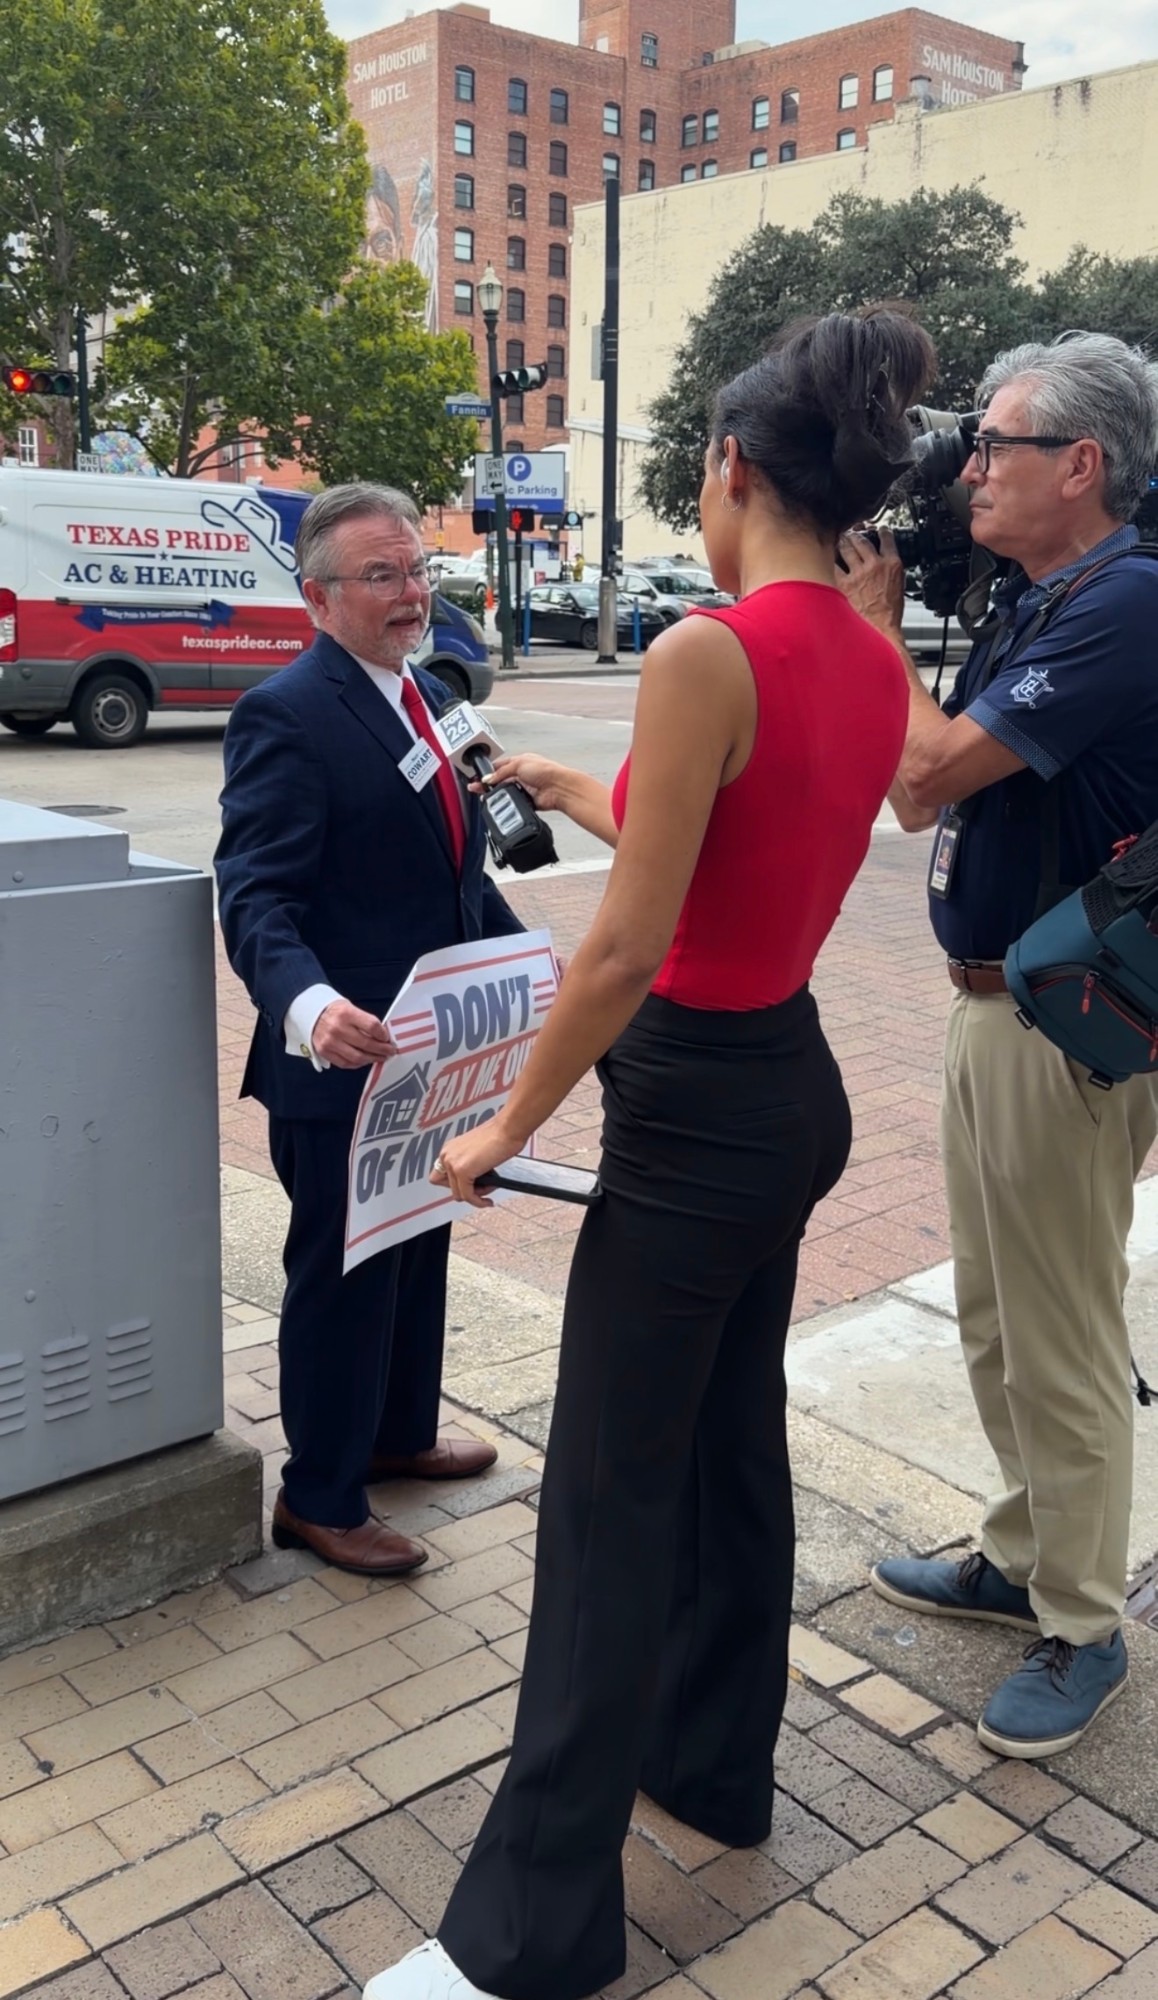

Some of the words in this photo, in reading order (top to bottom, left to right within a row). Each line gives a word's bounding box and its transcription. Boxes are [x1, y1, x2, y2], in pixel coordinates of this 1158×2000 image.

[353, 60, 377, 84] SAM
[379, 42, 427, 75] HOUSTON
[922, 44, 951, 75] SAM
[952, 54, 1005, 92] HOUSTON
[370, 81, 409, 110] HOTEL
[451, 405, 487, 416] Fannin
[80, 455, 99, 465] ONE
[487, 460, 502, 470] ONE
[488, 471, 503, 479] WAY
[517, 485, 558, 497] Parking
[66, 524, 160, 548] TEXAS
[165, 529, 251, 552] PRIDE
[64, 563, 102, 583] AC
[109, 564, 128, 585] &
[134, 565, 258, 589] HEATING
[182, 634, 303, 653] texasprideac.com
[443, 710, 463, 729] FOX
[446, 720, 470, 743] 26
[407, 748, 433, 780] COWART
[432, 974, 531, 1061] DON'T
[426, 1062, 475, 1121] TAX
[467, 1048, 508, 1102] ME
[356, 1142, 405, 1204] OF
[397, 1121, 454, 1188] MY
